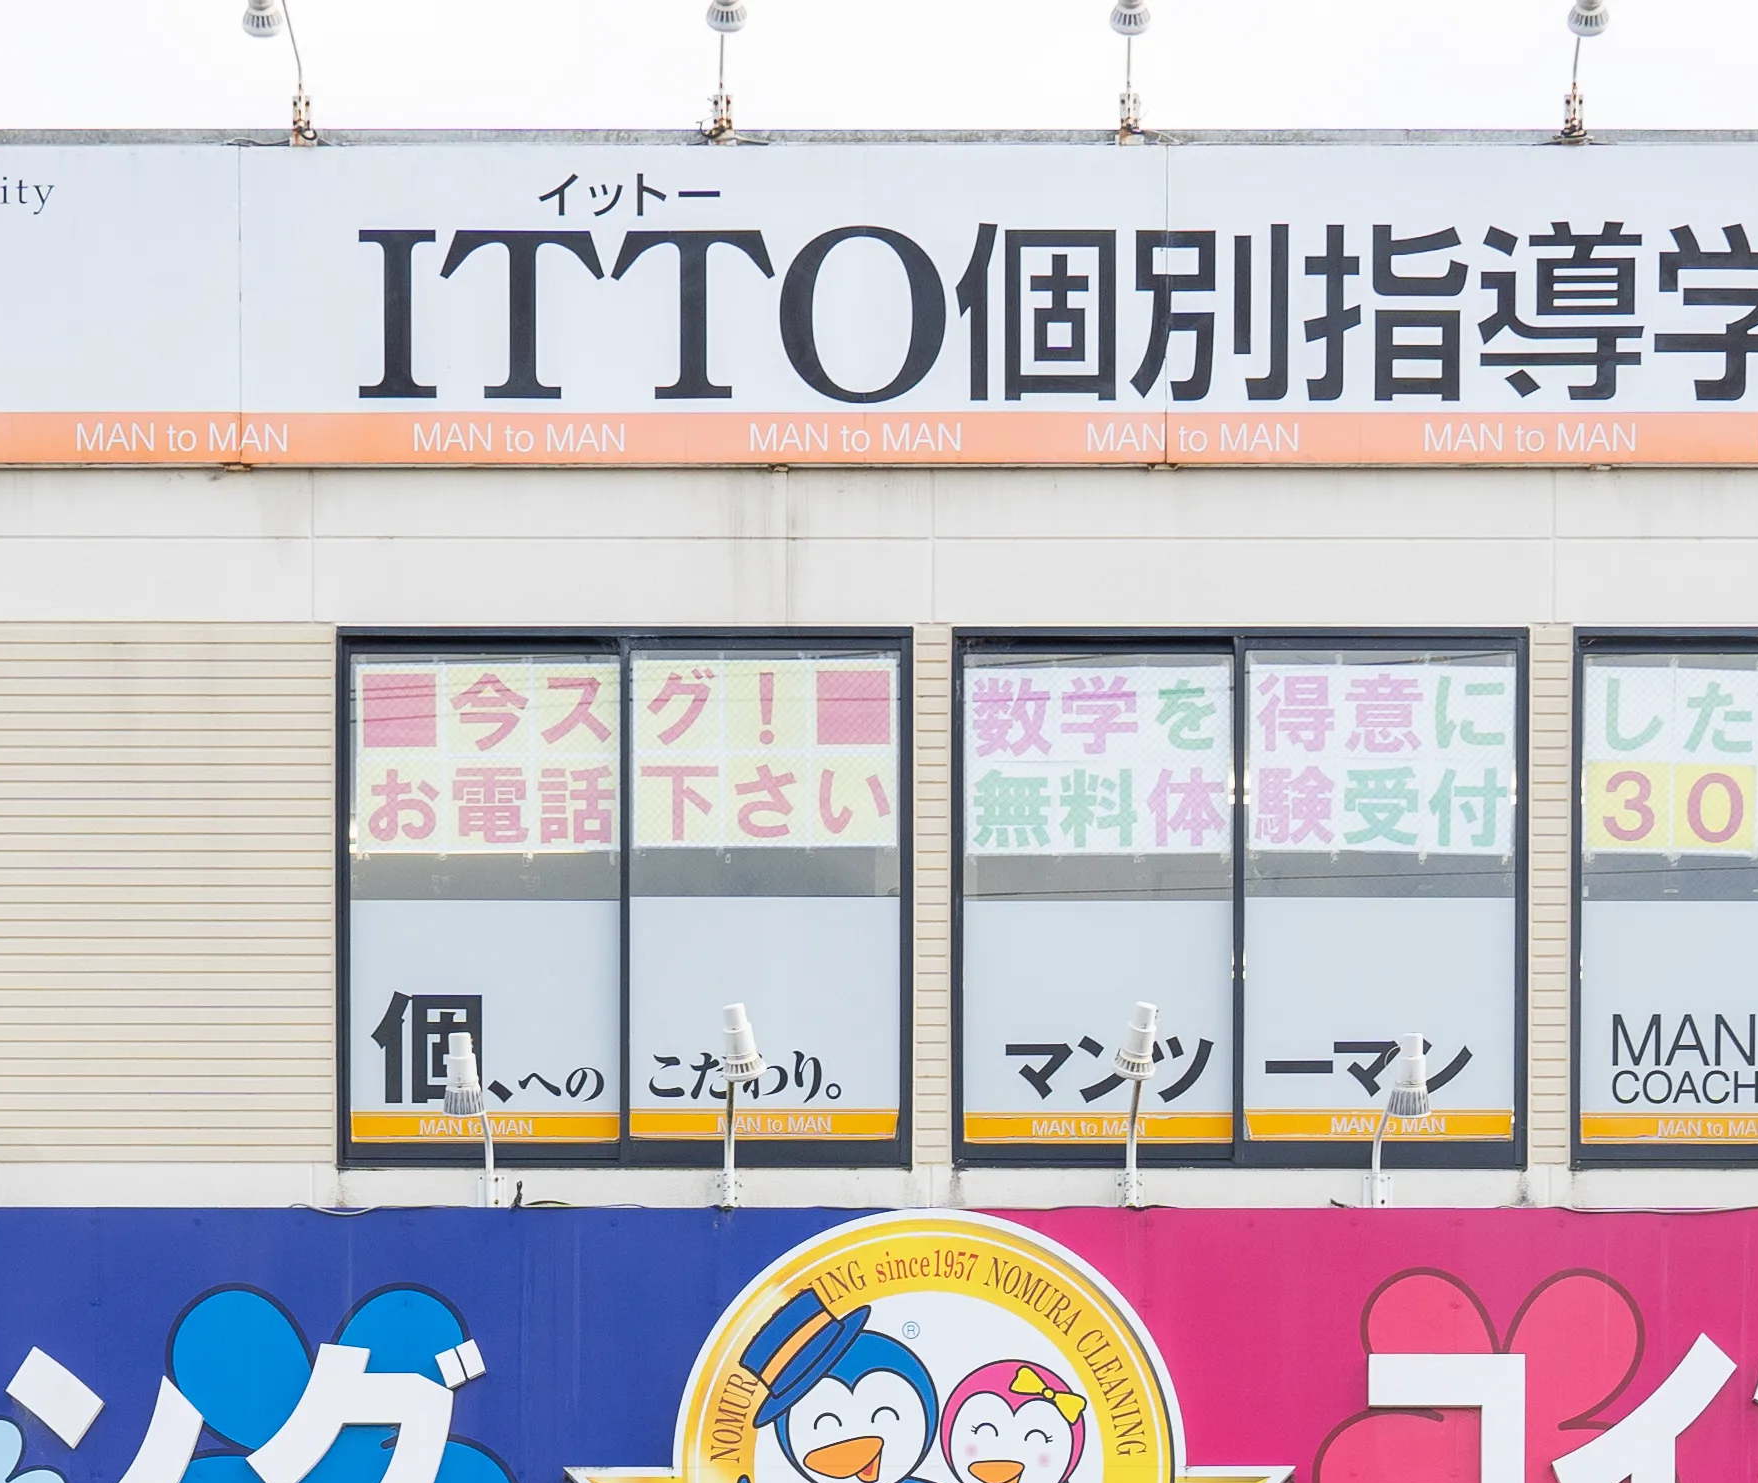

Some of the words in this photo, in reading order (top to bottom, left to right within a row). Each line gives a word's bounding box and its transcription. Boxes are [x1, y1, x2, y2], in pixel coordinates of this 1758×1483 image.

[538, 173, 720, 216] イットー
[77, 423, 154, 451] MAN
[167, 425, 196, 451] to
[209, 422, 287, 451] MAN
[414, 422, 491, 451] MAN
[505, 425, 534, 452] to
[547, 424, 624, 452] MAN
[750, 423, 828, 451] MAN
[840, 426, 870, 452] to
[883, 423, 961, 451] MAN
[1088, 423, 1165, 451] MAN
[1179, 426, 1208, 452] to
[1221, 423, 1298, 451] MAN
[1425, 423, 1503, 451] MAN
[1515, 425, 1545, 451] to
[1558, 423, 1635, 451] MAN
[972, 672, 1506, 757] 数学を得意に
[369, 764, 891, 844] お電話下さい
[973, 766, 1508, 848] 無料体験受付
[1612, 1013, 1755, 1066] MAN
[420, 1118, 463, 1135] MAN
[490, 1118, 533, 1135] MAN
[1658, 1119, 1701, 1136] MAN
[1706, 1119, 1723, 1136] to
[985, 1256, 1080, 1338] NOMURA
[1076, 1327, 1148, 1460] CLEANING
